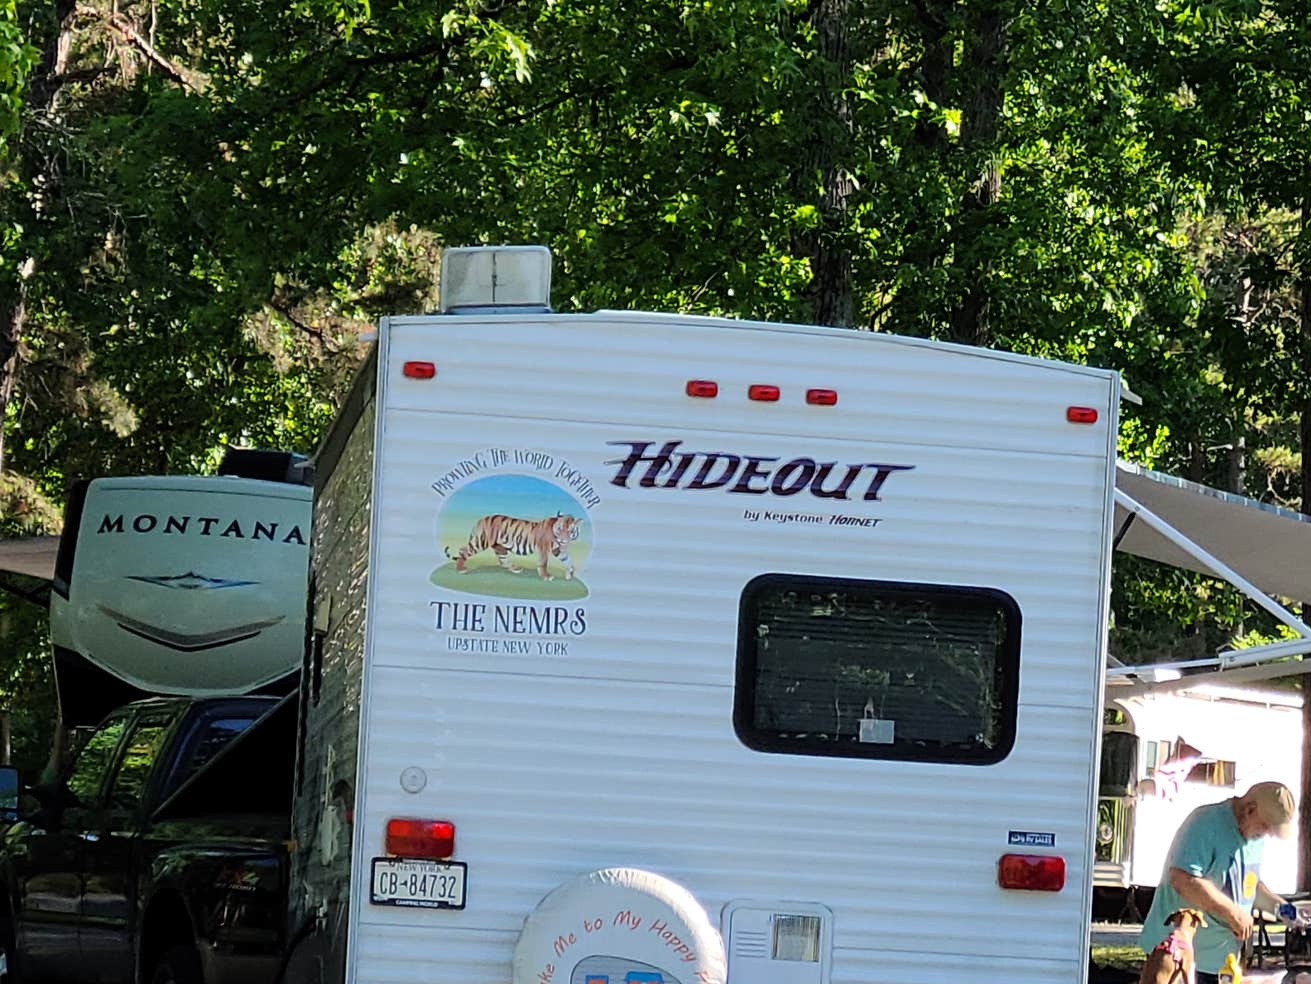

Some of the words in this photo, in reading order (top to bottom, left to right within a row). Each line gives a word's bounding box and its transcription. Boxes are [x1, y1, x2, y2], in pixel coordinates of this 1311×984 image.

[489, 448, 511, 467] THE
[514, 449, 554, 471] WORLD
[555, 461, 601, 509] TOGETHER
[604, 440, 916, 502] HIDEOUT
[97, 514, 307, 545] MONTANA
[744, 509, 760, 522] by
[764, 511, 823, 526] Keystone
[430, 601, 486, 632] THE
[494, 605, 587, 636] NEMRS
[447, 636, 498, 653] UPSTATE
[503, 639, 532, 655] NEW
[536, 641, 569, 656] YORK
[553, 932, 577, 957] Me
[584, 917, 603, 933] to
[614, 910, 641, 930] My
[649, 919, 697, 963] Happy
